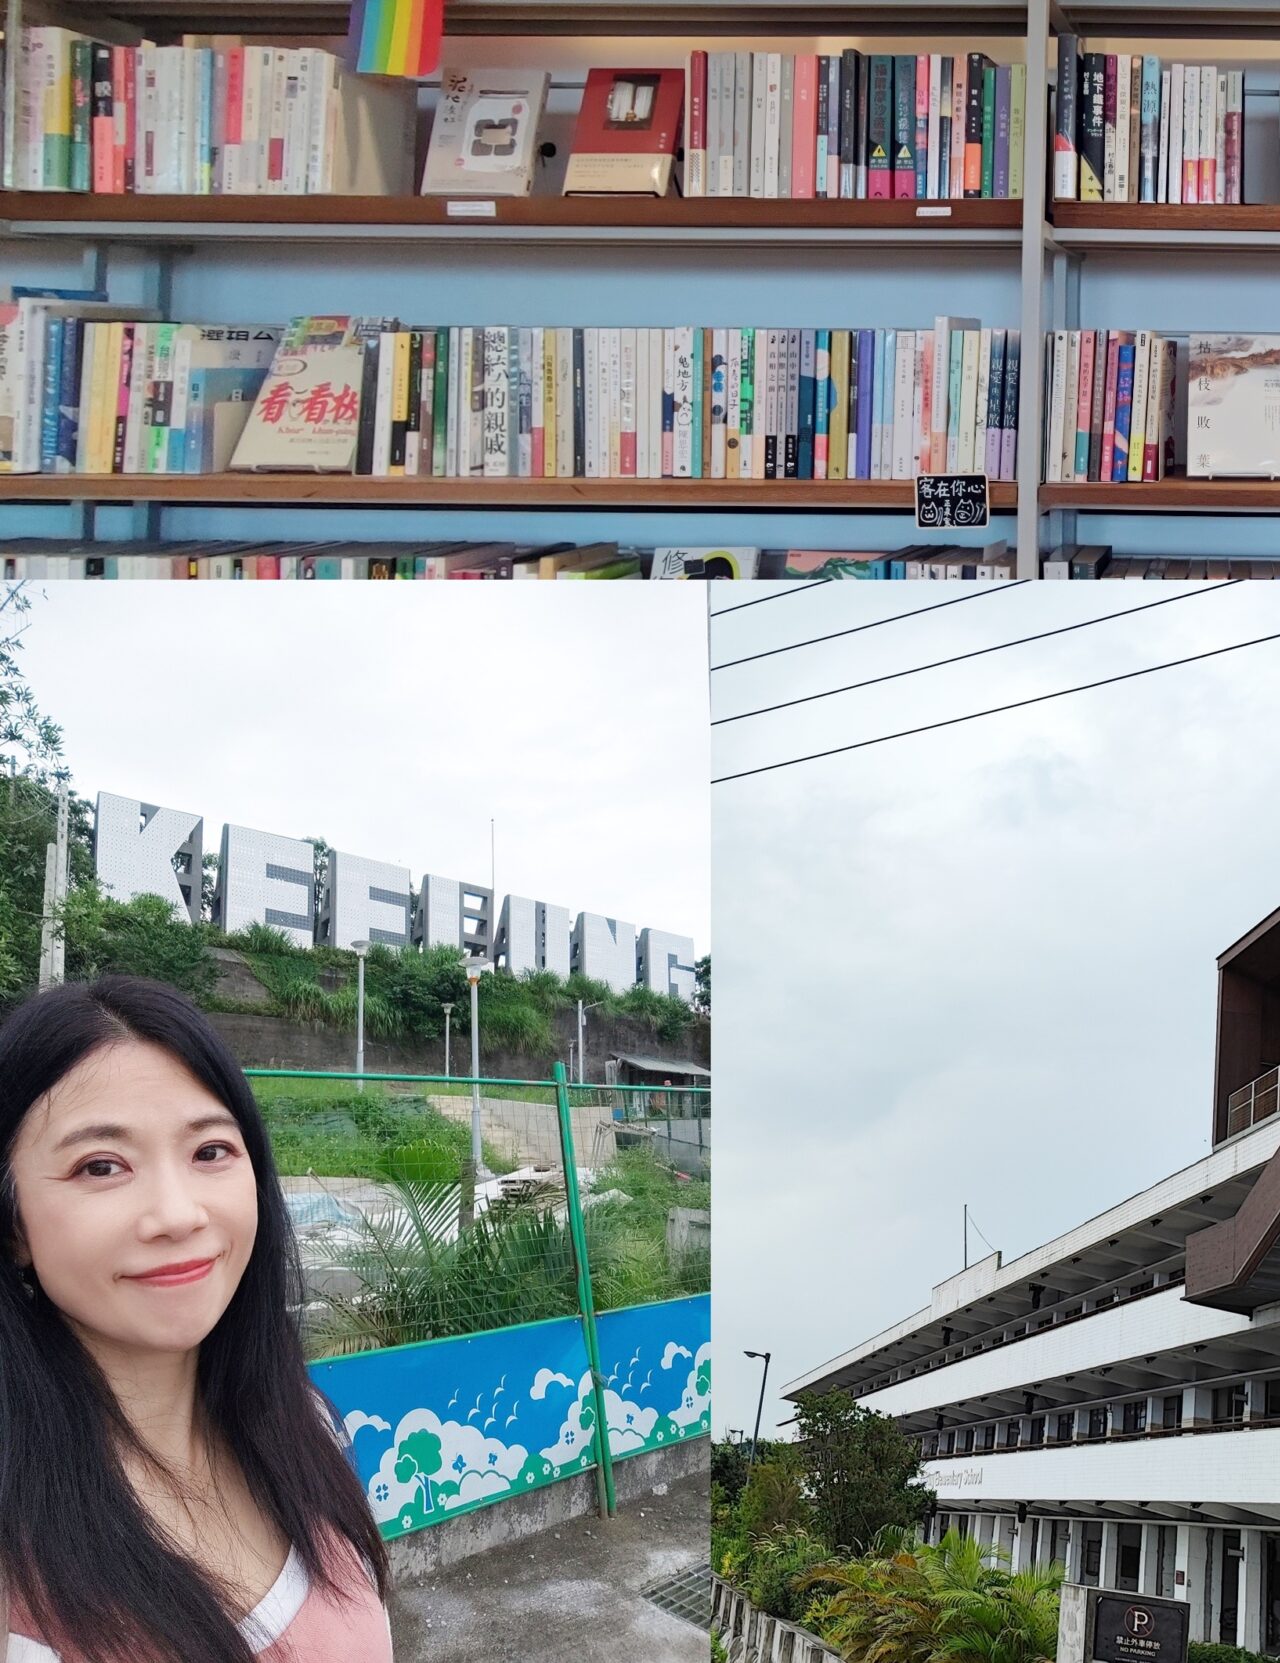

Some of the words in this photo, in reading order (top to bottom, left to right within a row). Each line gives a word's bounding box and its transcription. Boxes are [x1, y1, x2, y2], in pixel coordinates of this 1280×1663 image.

[676, 354, 692, 392] 鬼地方
[1196, 340, 1212, 469] 枯枝敗葉
[918, 476, 985, 498] 客在你心
[662, 549, 689, 575] 修
[1115, 1635, 1161, 1651] 禁止外車停放
[1129, 1647, 1156, 1657] PARKING
